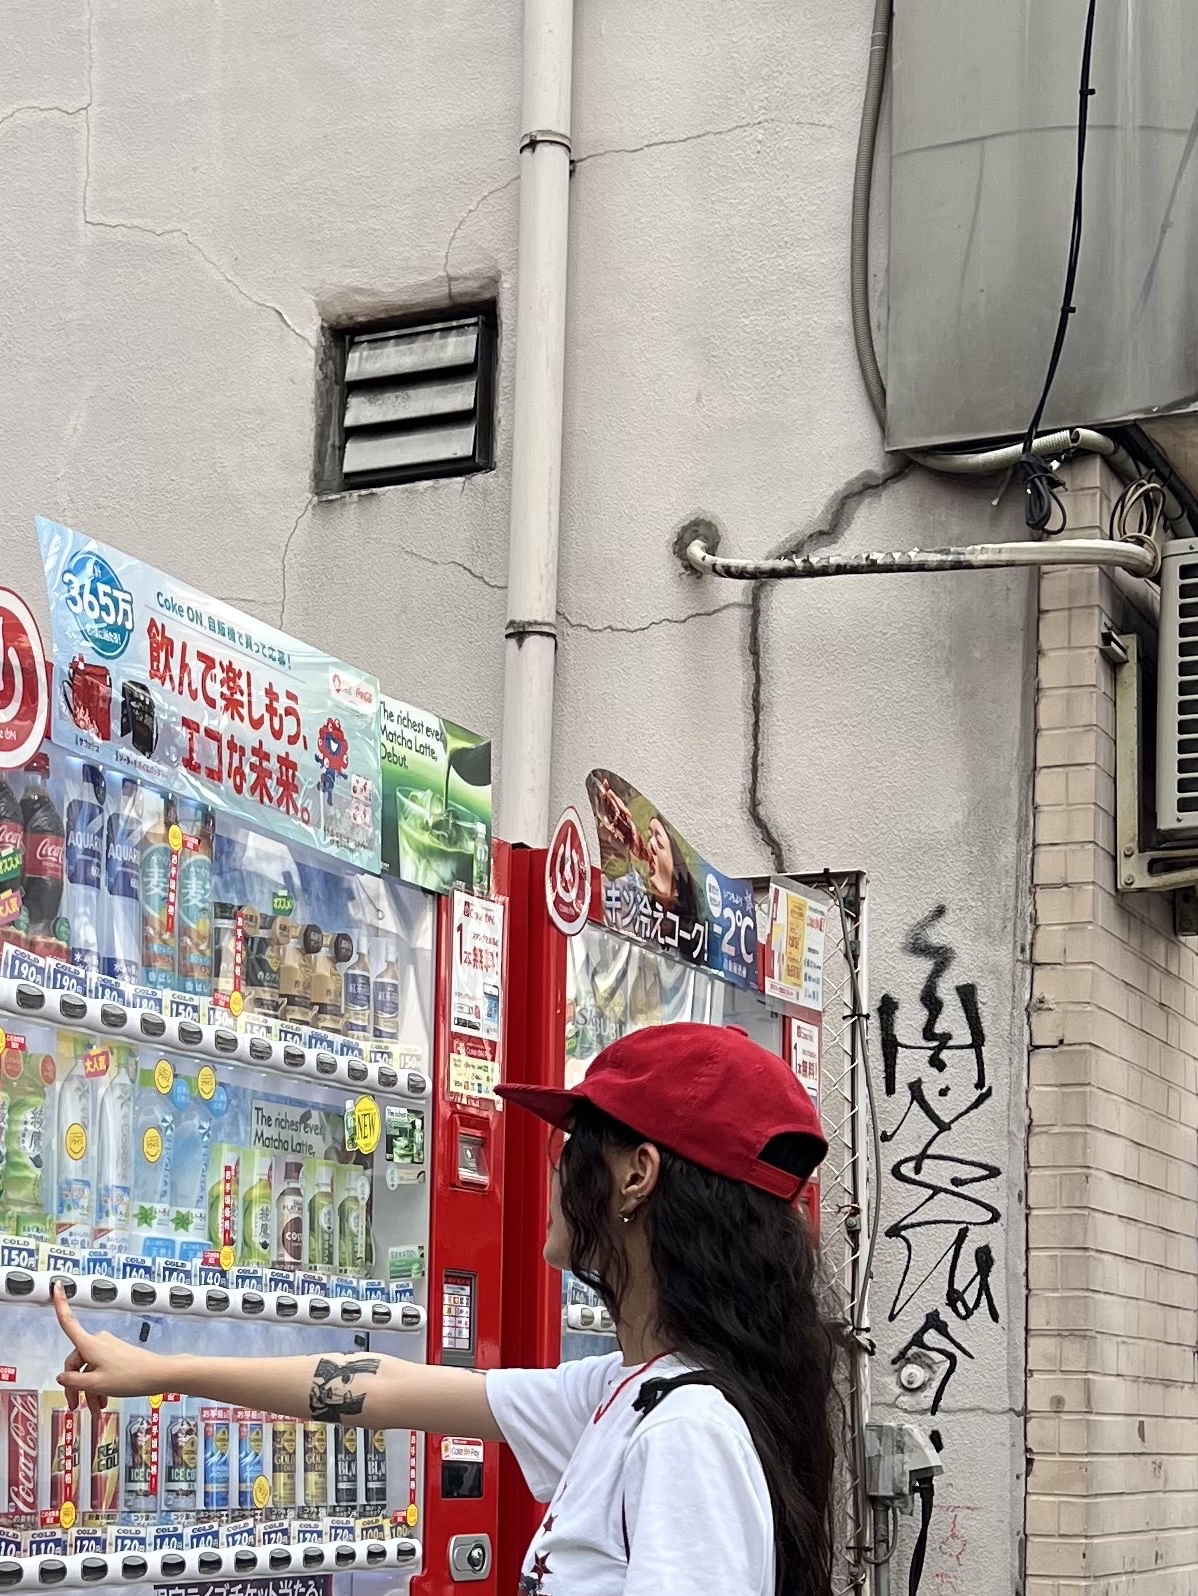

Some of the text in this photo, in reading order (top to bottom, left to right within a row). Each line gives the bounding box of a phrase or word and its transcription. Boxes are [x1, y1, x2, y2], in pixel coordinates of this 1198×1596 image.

[62, 571, 134, 633] 365万
[156, 592, 184, 618] Coke
[147, 617, 308, 751] 飲んで楽しもう、
[396, 709, 424, 733] richest
[181, 716, 310, 826] エコな未来。
[14, 949, 40, 964] COLD
[55, 962, 81, 976] COLD
[172, 992, 194, 1003] COLD
[255, 1106, 273, 1127] The
[358, 1111, 376, 1140] NEW
[254, 1129, 290, 1150] Matcha
[3, 1238, 30, 1247] COLD
[49, 1247, 75, 1257] COLD
[125, 1256, 146, 1265] COLD
[164, 1259, 186, 1269] COLD
[8, 1394, 40, 1516] Coca-Cola
[116, 1528, 142, 1536] COLD
[155, 1526, 179, 1534] COLD
[192, 1524, 215, 1534] COLD
[263, 1521, 285, 1531] COLD
[31, 1531, 57, 1539] COLD
